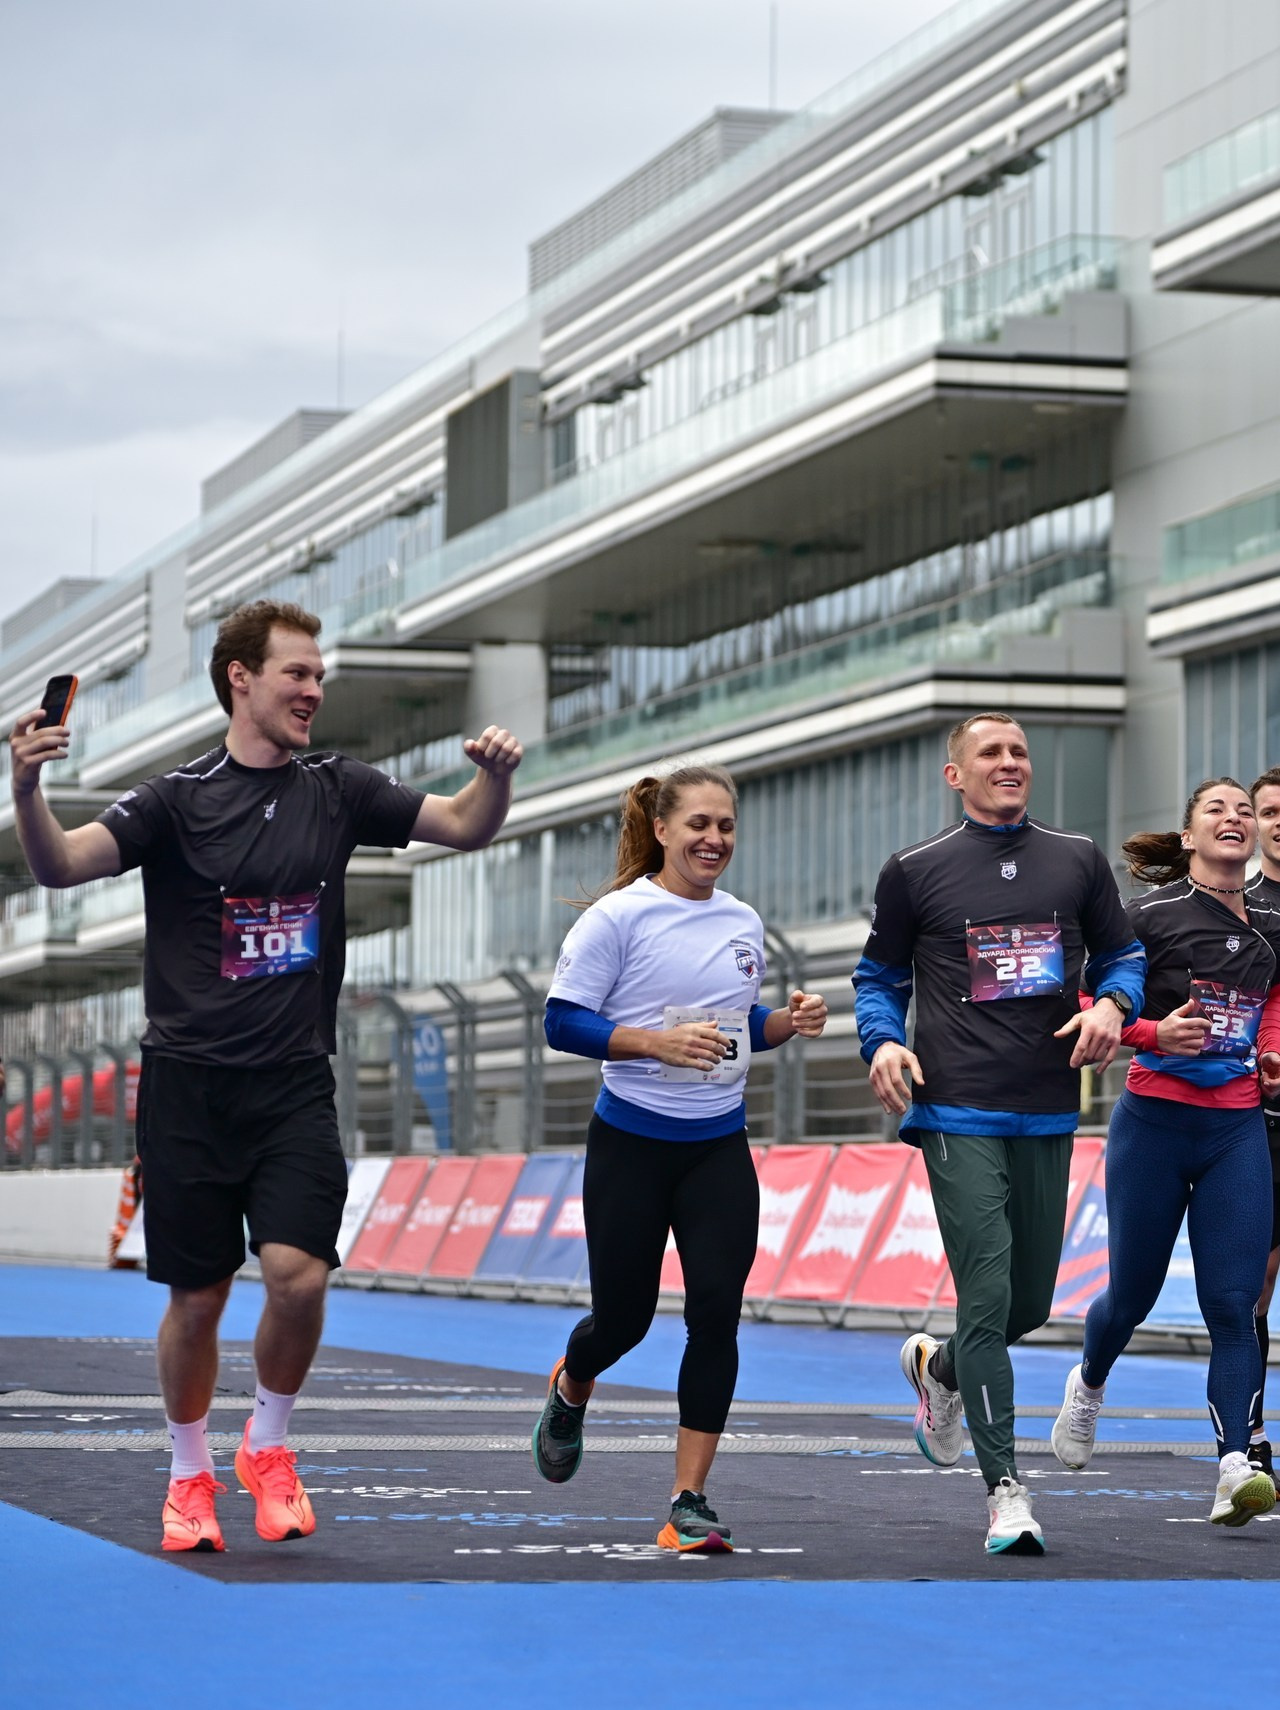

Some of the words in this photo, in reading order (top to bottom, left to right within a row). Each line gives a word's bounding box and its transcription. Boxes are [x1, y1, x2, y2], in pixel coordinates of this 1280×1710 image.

[245, 923, 279, 932] ЕВГЕНИЙ
[280, 922, 303, 930] ГЕНИН
[240, 930, 306, 958] 101
[977, 950, 1005, 958] ЭДУАРД
[1006, 946, 1056, 956] ТРОЯНОВСКИЙ
[996, 956, 1042, 981] 22
[1205, 1005, 1225, 1013] ДАРЬЯ
[1210, 1014, 1245, 1039] 23
